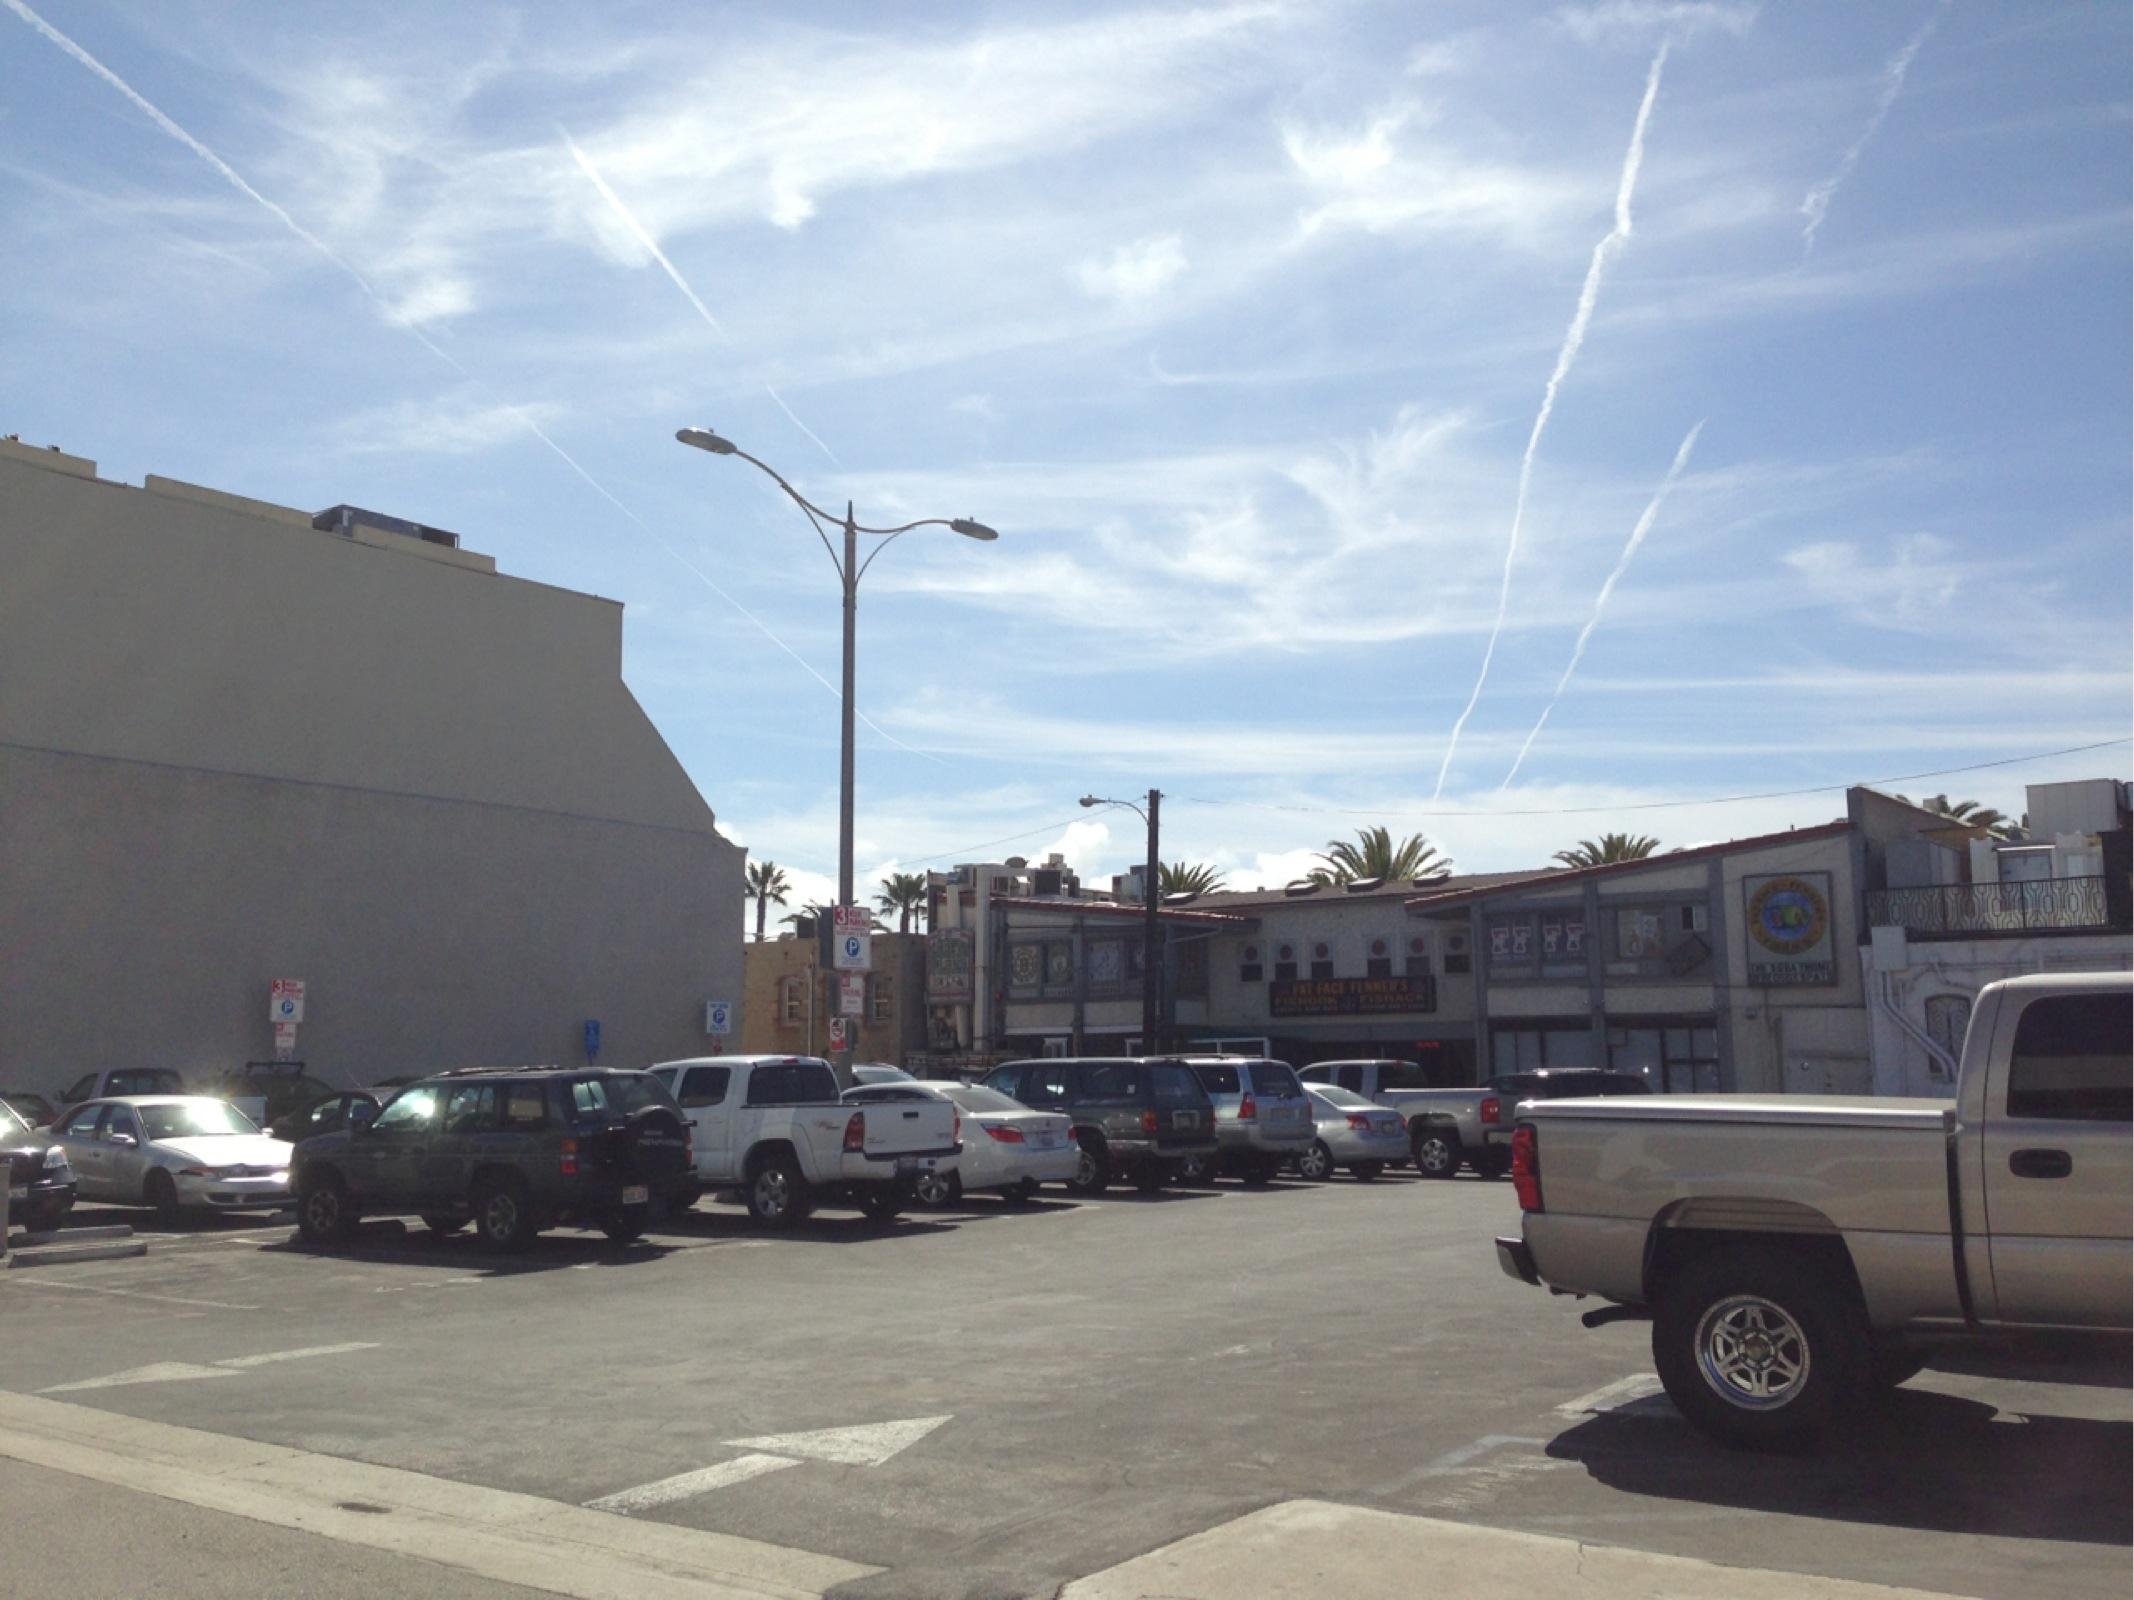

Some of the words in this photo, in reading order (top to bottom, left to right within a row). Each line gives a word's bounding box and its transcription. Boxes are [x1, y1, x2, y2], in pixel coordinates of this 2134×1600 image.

[836, 906, 846, 924] 3
[1292, 983, 1312, 995] FAT
[1317, 981, 1345, 994] FACE
